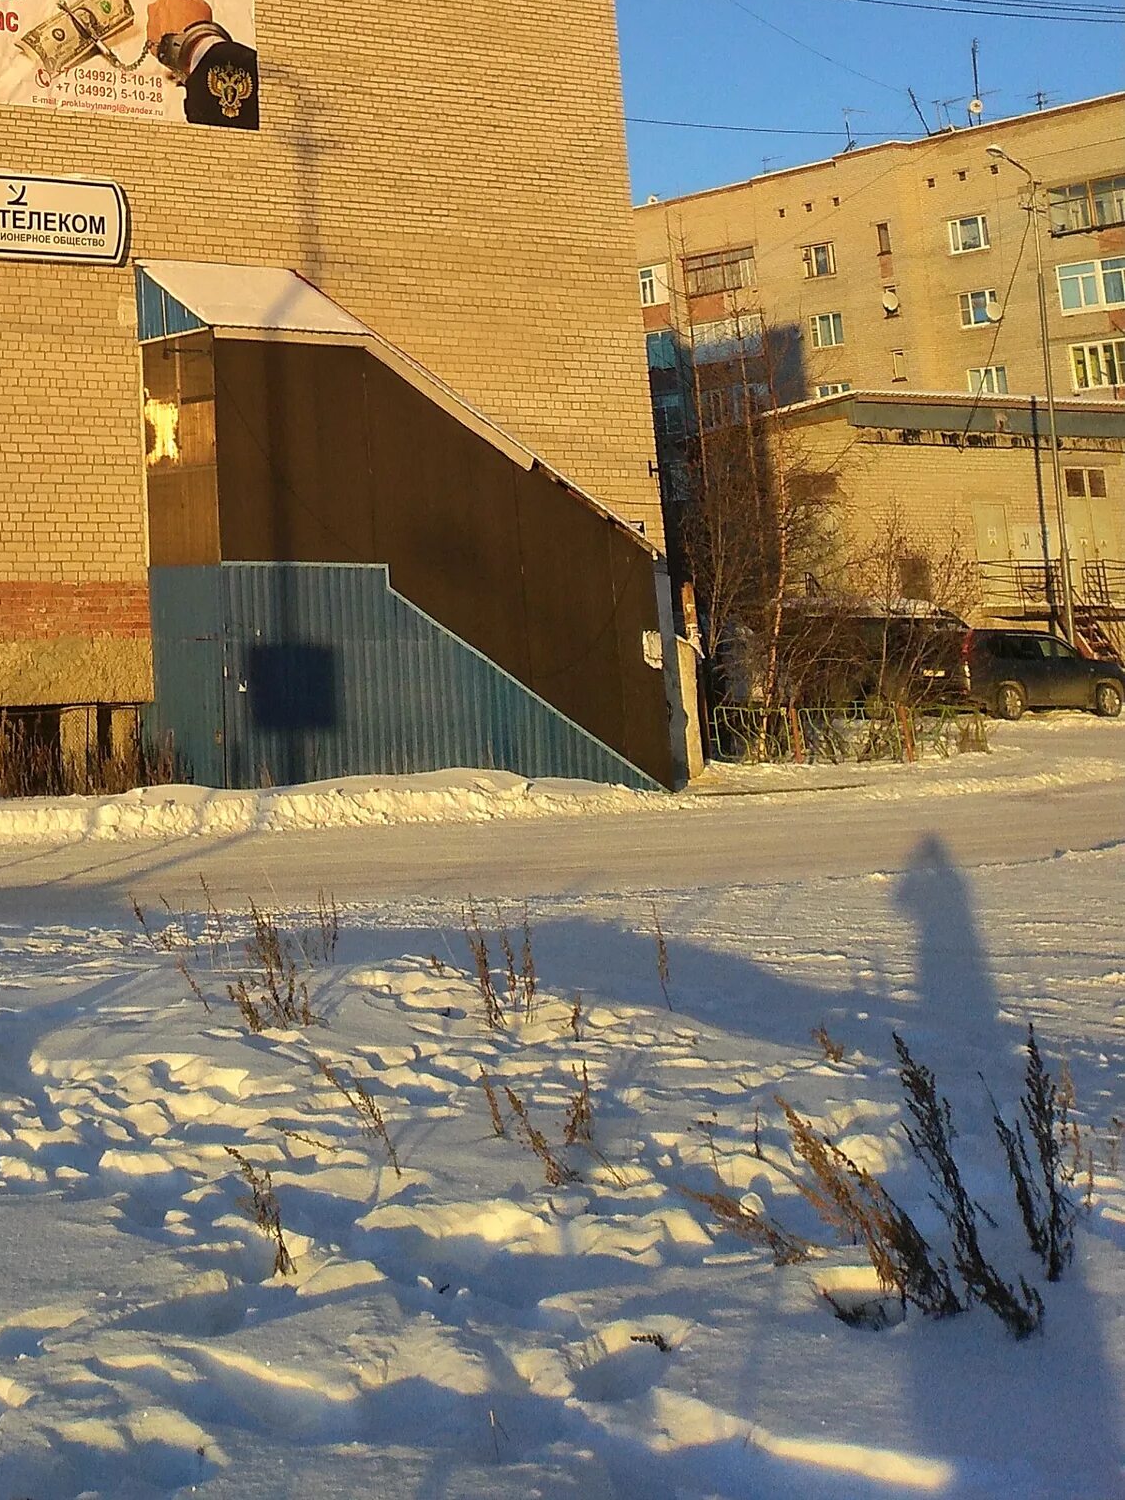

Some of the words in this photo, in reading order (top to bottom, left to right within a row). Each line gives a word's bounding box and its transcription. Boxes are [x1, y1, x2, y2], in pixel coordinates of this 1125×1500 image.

[74, 68, 117, 85] (34992)
[120, 73, 163, 88] 5-10-18
[56, 82, 70, 93] +7
[74, 84, 117, 100] (34992)
[121, 88, 163, 103] 5-10-28
[53, 235, 105, 247] ОБЩЕСТВО
